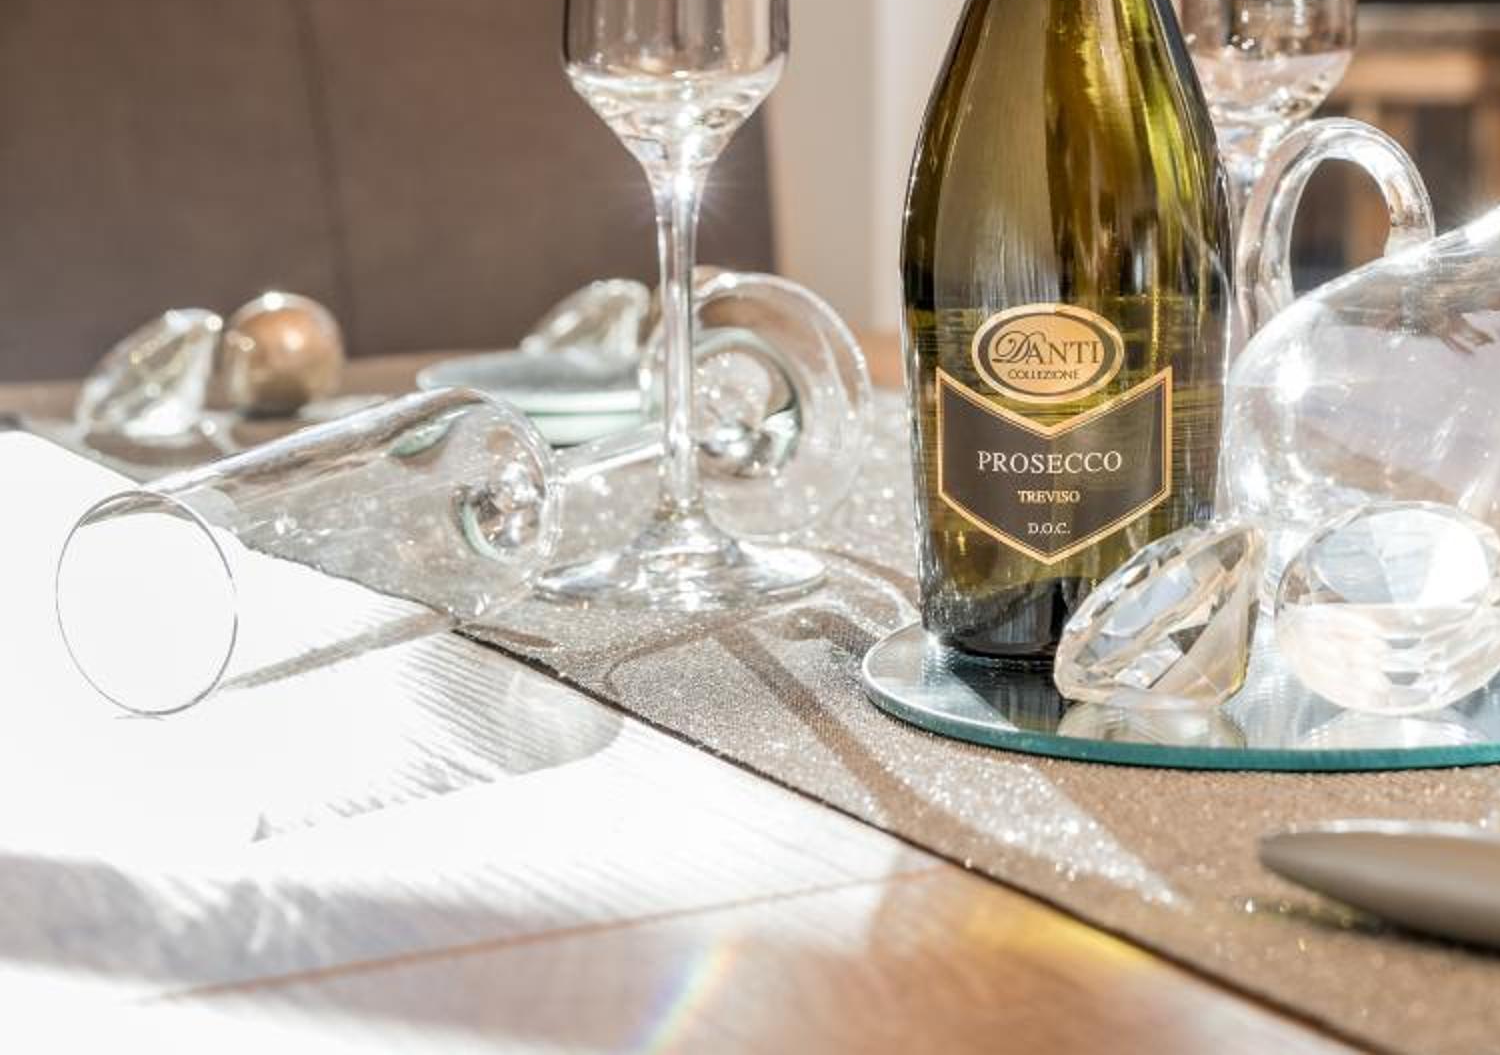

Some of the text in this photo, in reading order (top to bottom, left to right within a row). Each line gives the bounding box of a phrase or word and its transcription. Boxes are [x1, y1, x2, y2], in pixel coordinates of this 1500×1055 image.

[1008, 369, 1080, 380] COLLEZIONE
[977, 450, 1122, 474] PROSECCO
[1018, 490, 1080, 503] TREVISO
[1027, 522, 1071, 534] D.O.C.
